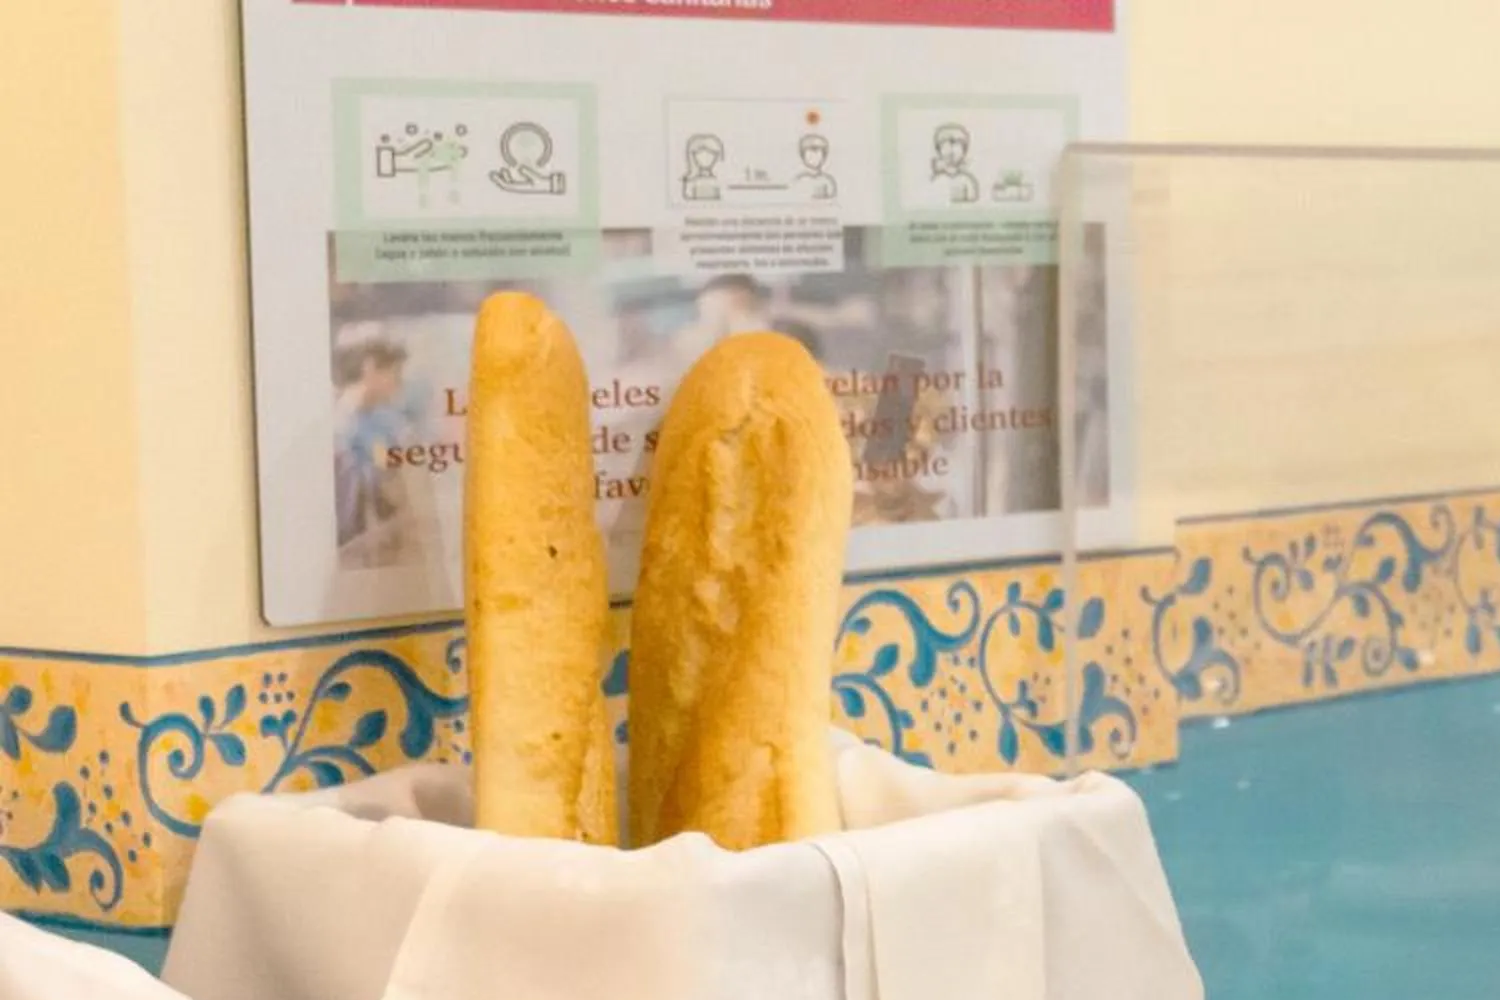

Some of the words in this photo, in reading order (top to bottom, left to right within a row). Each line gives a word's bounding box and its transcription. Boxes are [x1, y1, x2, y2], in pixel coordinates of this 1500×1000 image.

[591, 378, 661, 409] eles
[911, 367, 966, 403] por
[978, 360, 1005, 391] la
[932, 405, 1053, 435] clientes
[592, 469, 650, 501] fav
